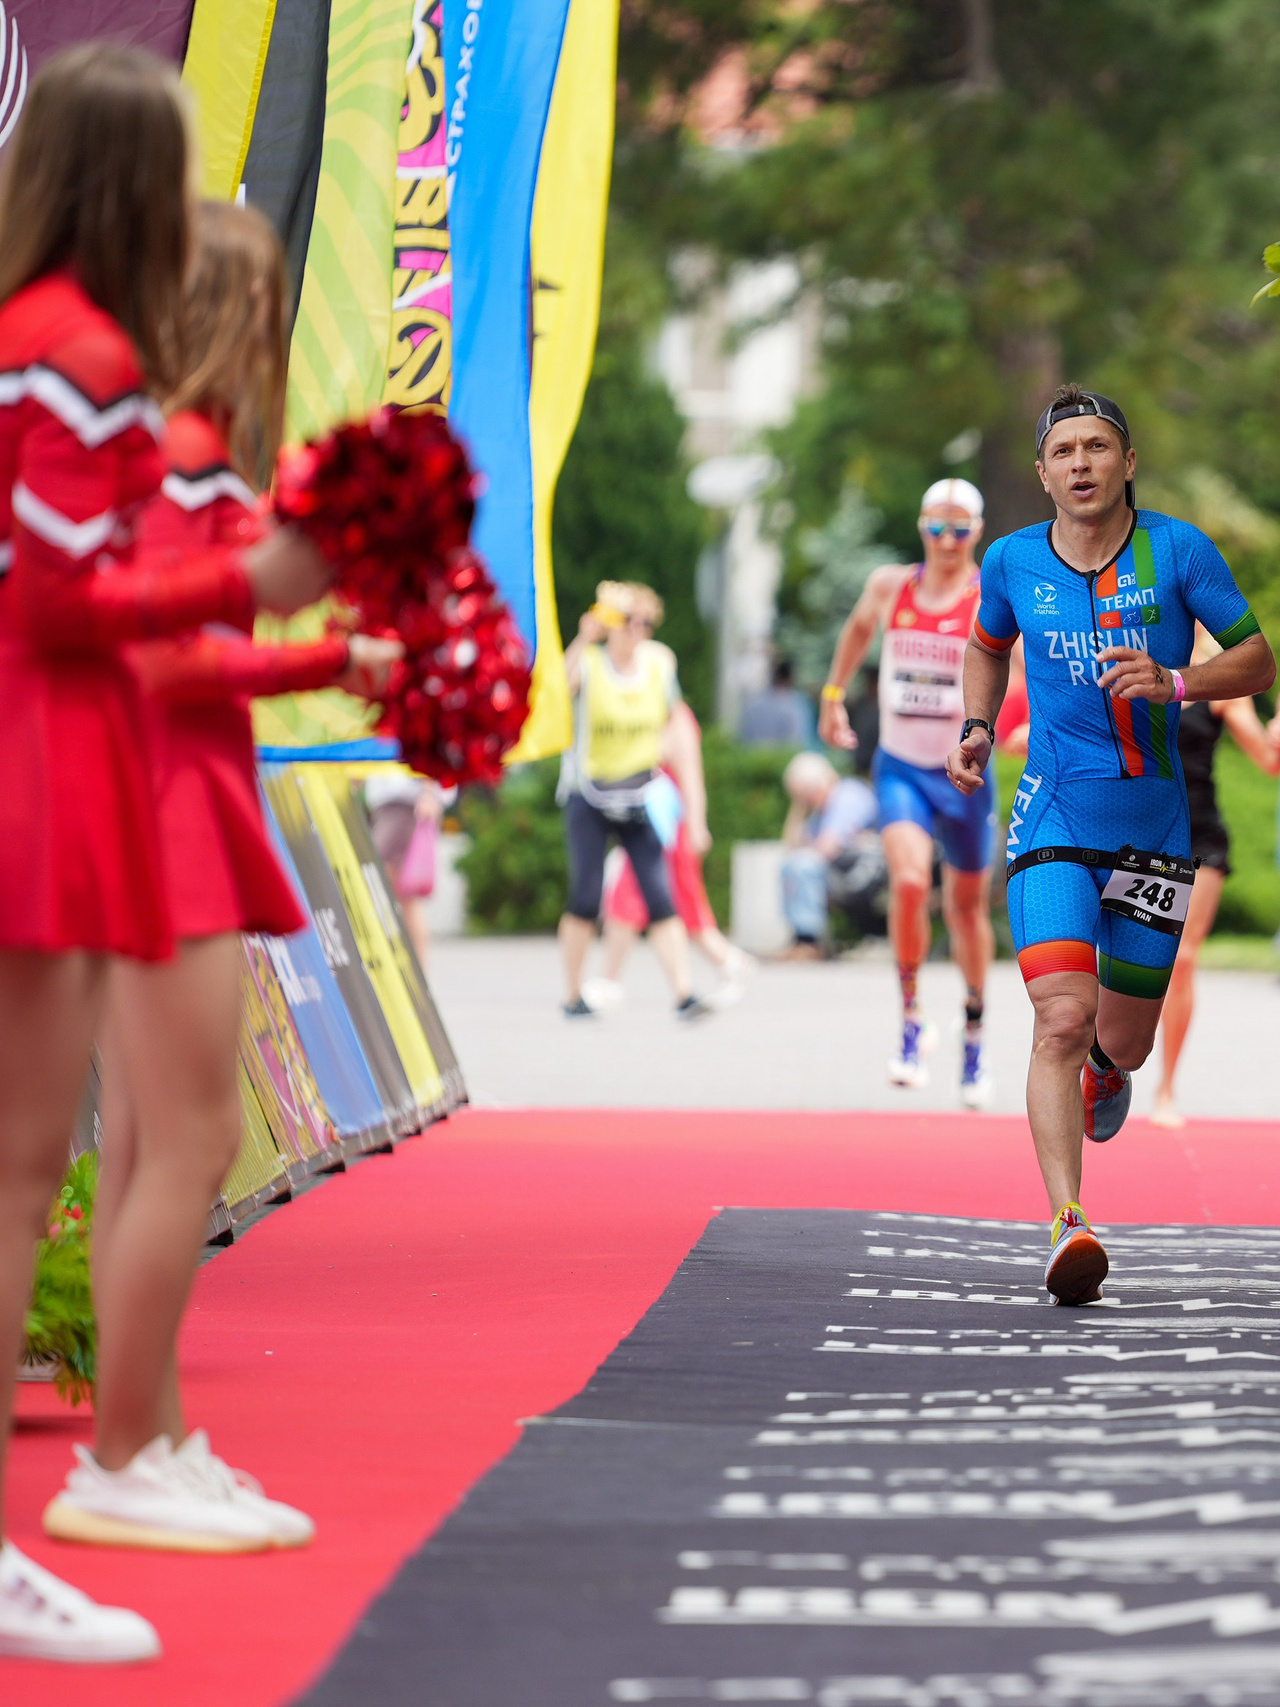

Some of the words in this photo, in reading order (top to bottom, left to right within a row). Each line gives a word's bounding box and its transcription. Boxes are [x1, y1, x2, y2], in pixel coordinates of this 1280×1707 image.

[1101, 588, 1155, 611] ТЕМП
[1068, 660, 1121, 686] RU
[1123, 878, 1176, 912] 248
[1133, 908, 1152, 922] IVAN
